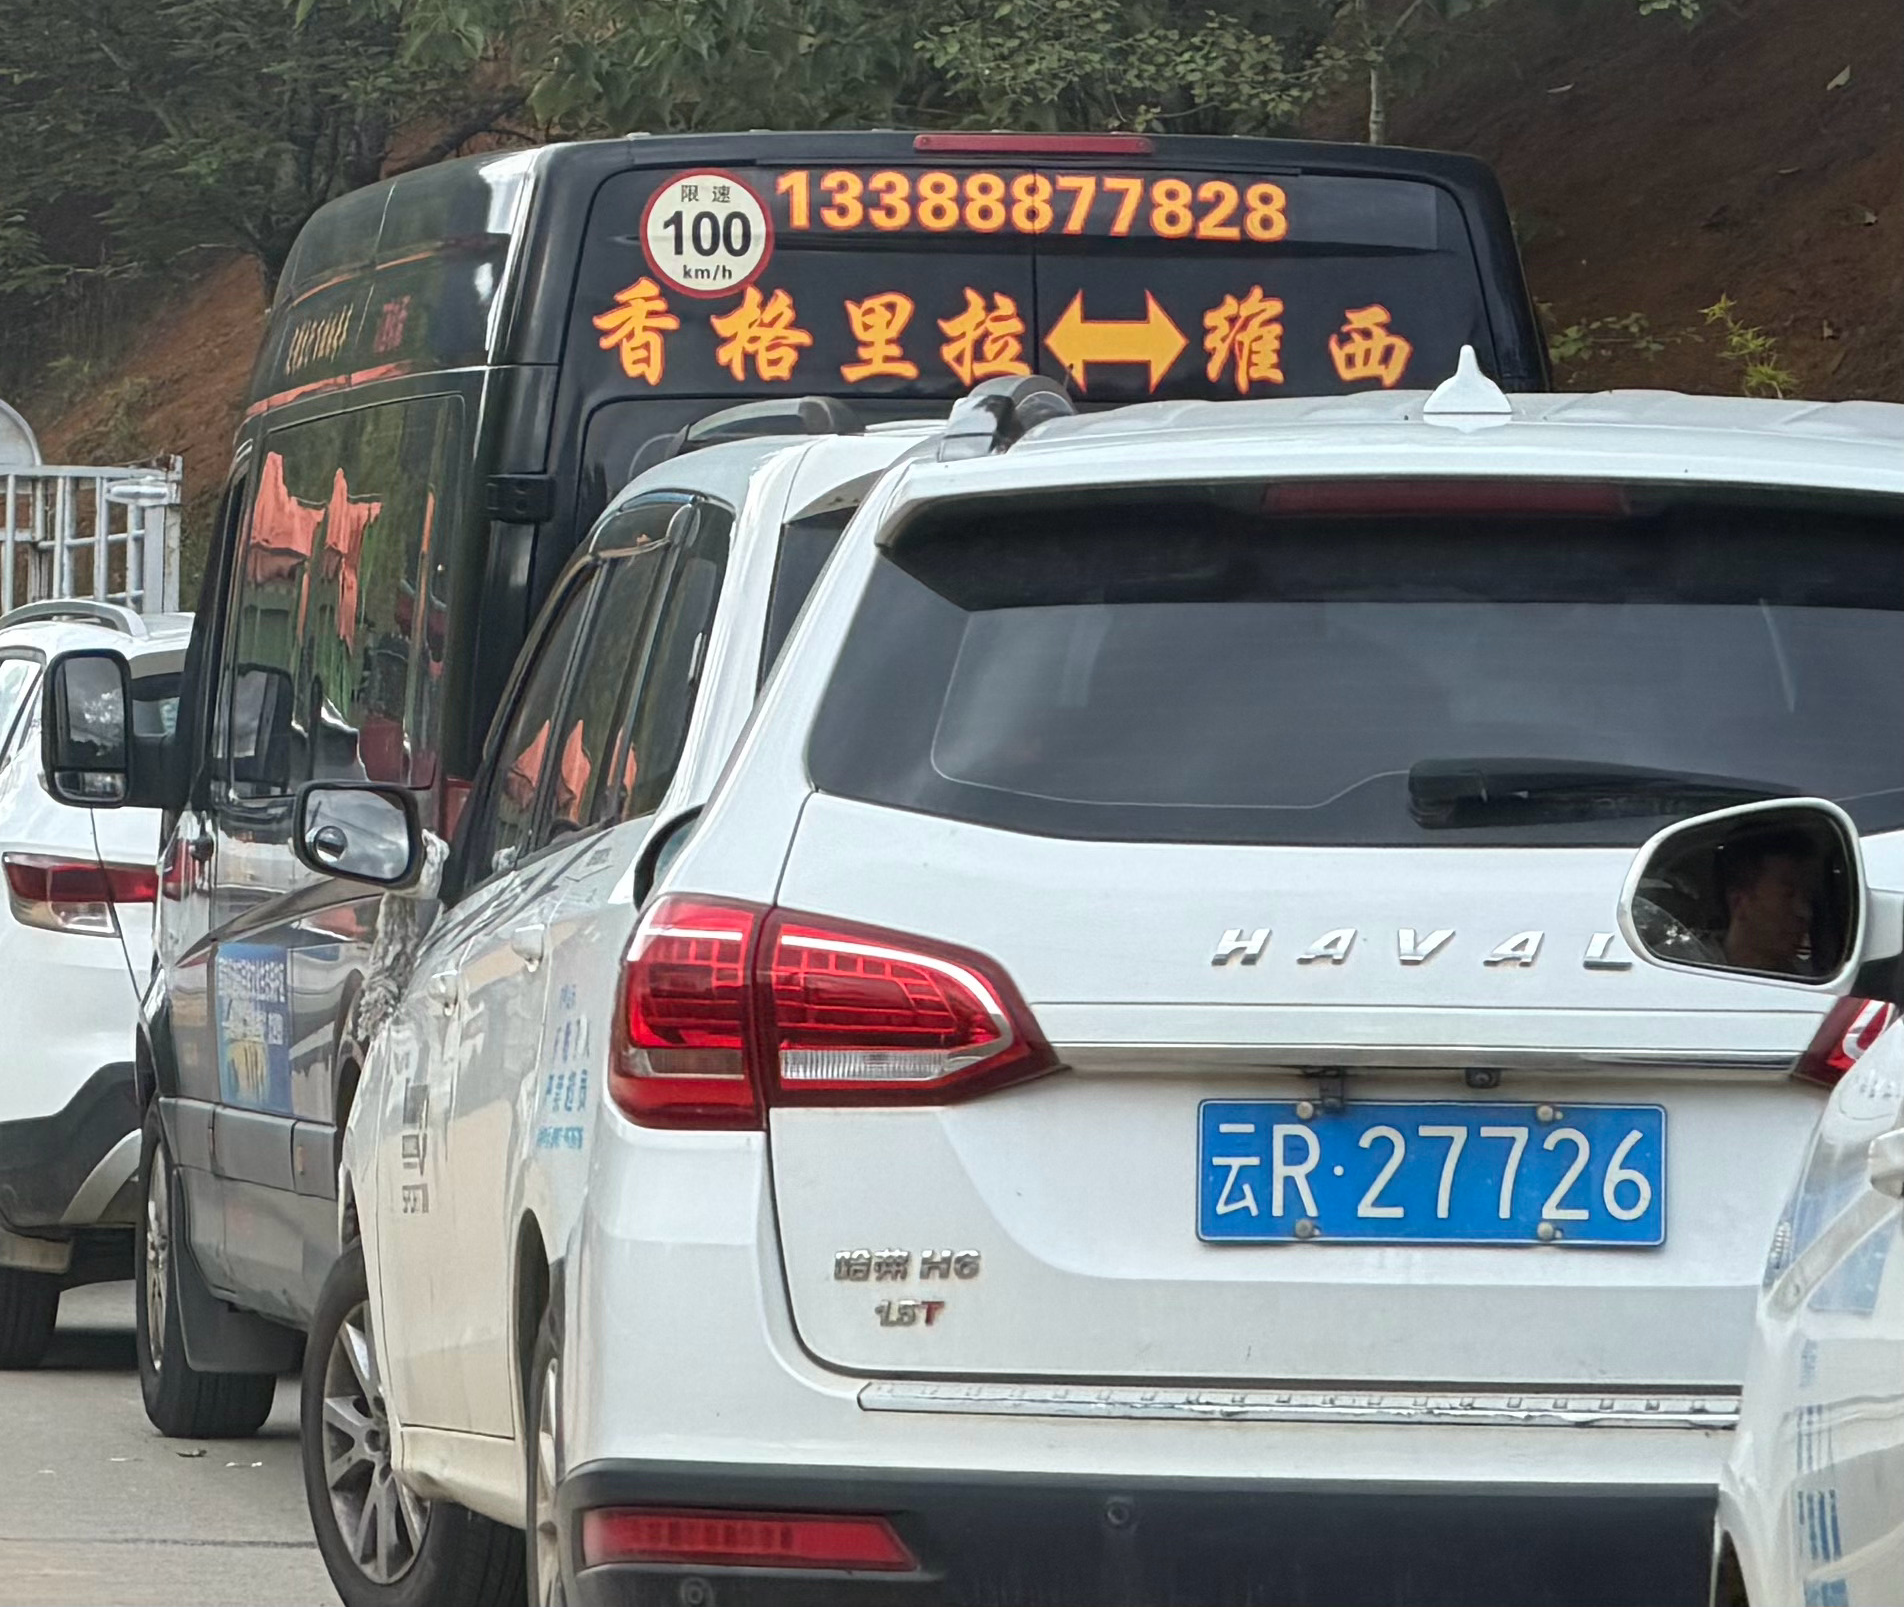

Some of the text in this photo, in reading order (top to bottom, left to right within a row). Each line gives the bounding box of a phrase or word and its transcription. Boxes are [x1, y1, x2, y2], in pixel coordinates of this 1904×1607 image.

[680, 183, 732, 204] 限速
[776, 168, 1289, 243] 13388877828
[663, 209, 752, 258] 100
[682, 264, 733, 281] km/h
[591, 275, 1414, 394] 香格里拉 维西
[1211, 927, 1634, 971] HAVAL
[919, 1248, 982, 1280] H6
